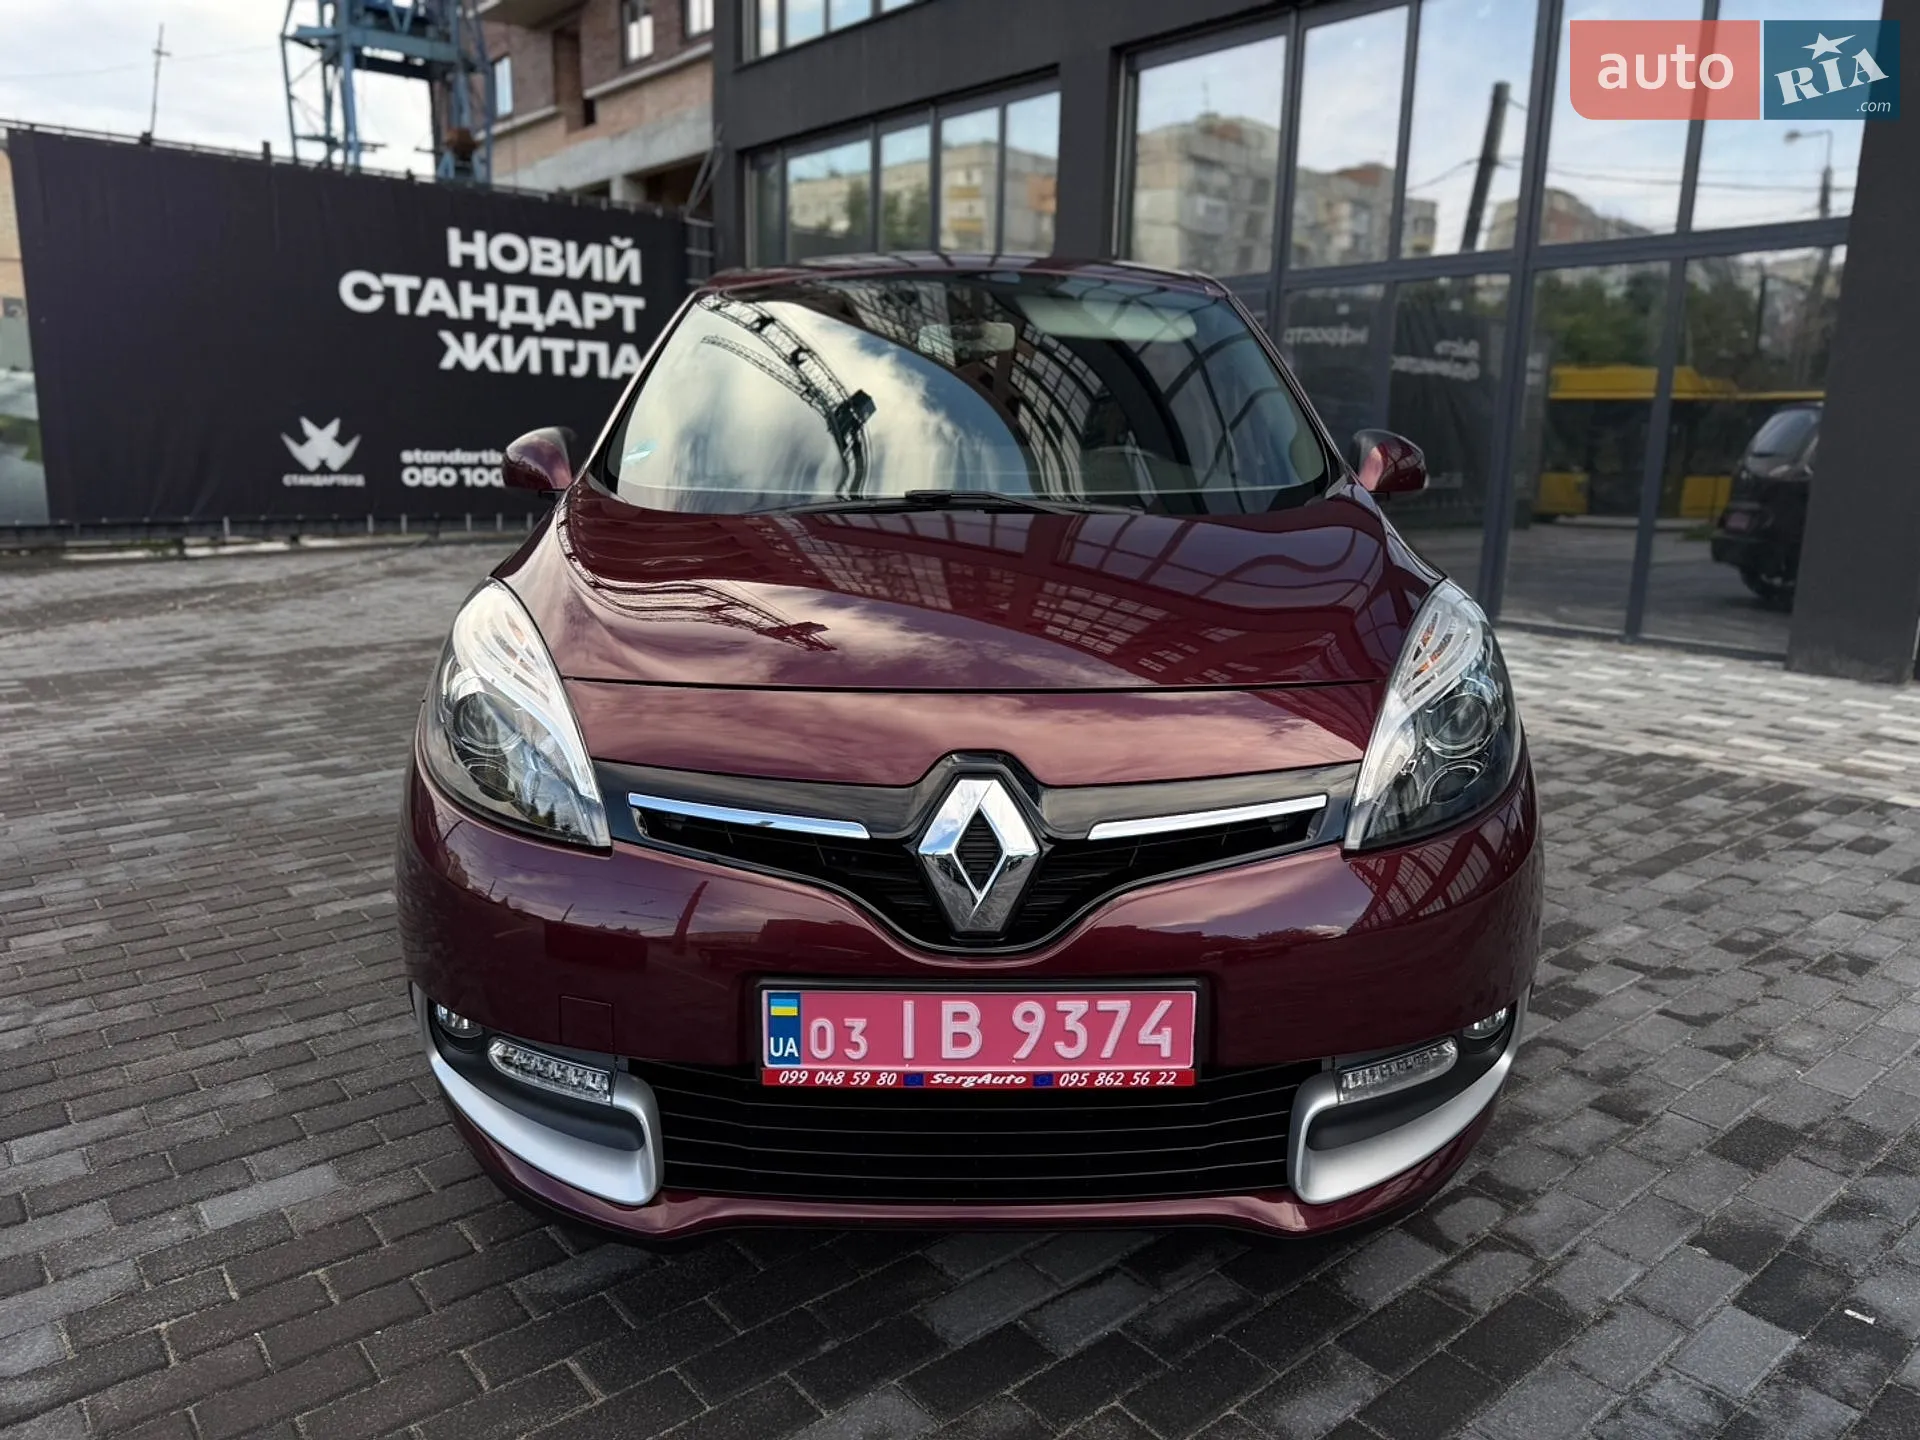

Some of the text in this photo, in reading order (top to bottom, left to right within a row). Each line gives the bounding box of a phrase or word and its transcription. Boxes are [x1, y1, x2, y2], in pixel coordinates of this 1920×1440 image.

[446, 227, 642, 285] НОВИЙ
[338, 270, 645, 333] СТАНДАРТ
[437, 330, 645, 380] ЖИТЛА
[401, 466, 459, 488] 050
[770, 1037, 799, 1058] UA
[809, 1000, 1174, 1060] 03 IB 9374
[779, 1071, 1177, 1087] 099 048 59 80 SergAuto 095 862 56 22
